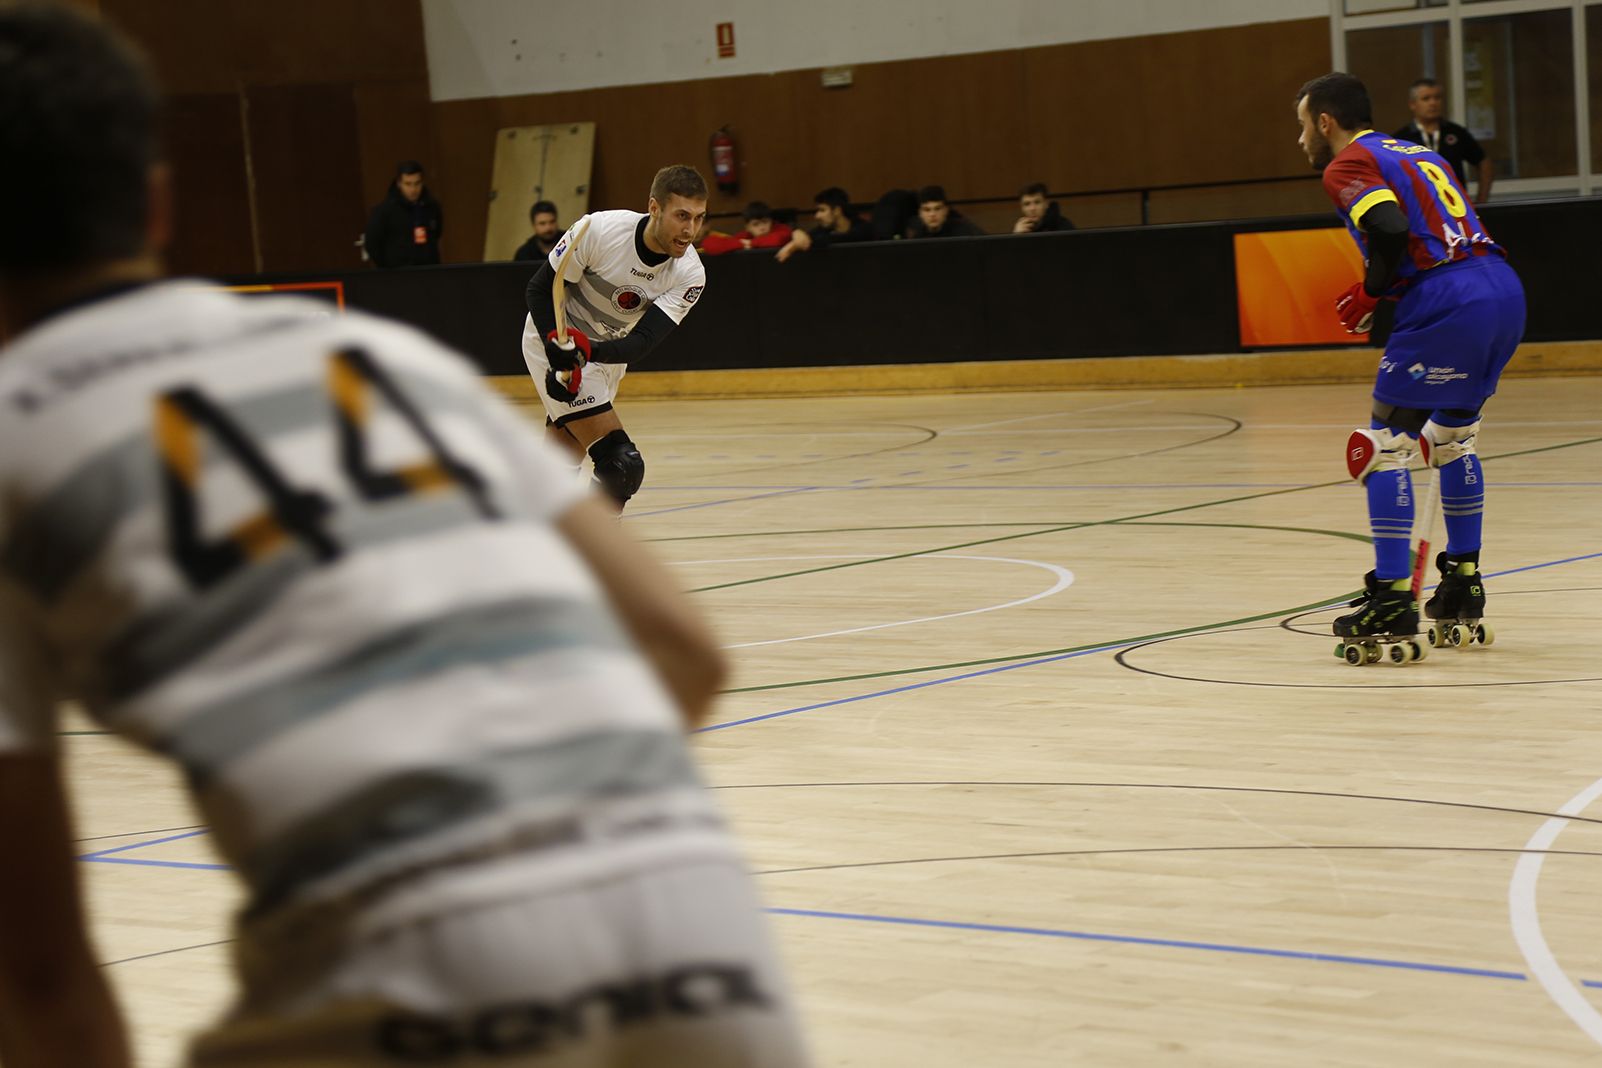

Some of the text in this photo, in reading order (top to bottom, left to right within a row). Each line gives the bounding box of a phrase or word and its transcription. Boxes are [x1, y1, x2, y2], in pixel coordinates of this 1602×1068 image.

[1416, 160, 1467, 218] 8
[630, 267, 647, 279] TUGA
[151, 342, 503, 592] 44
